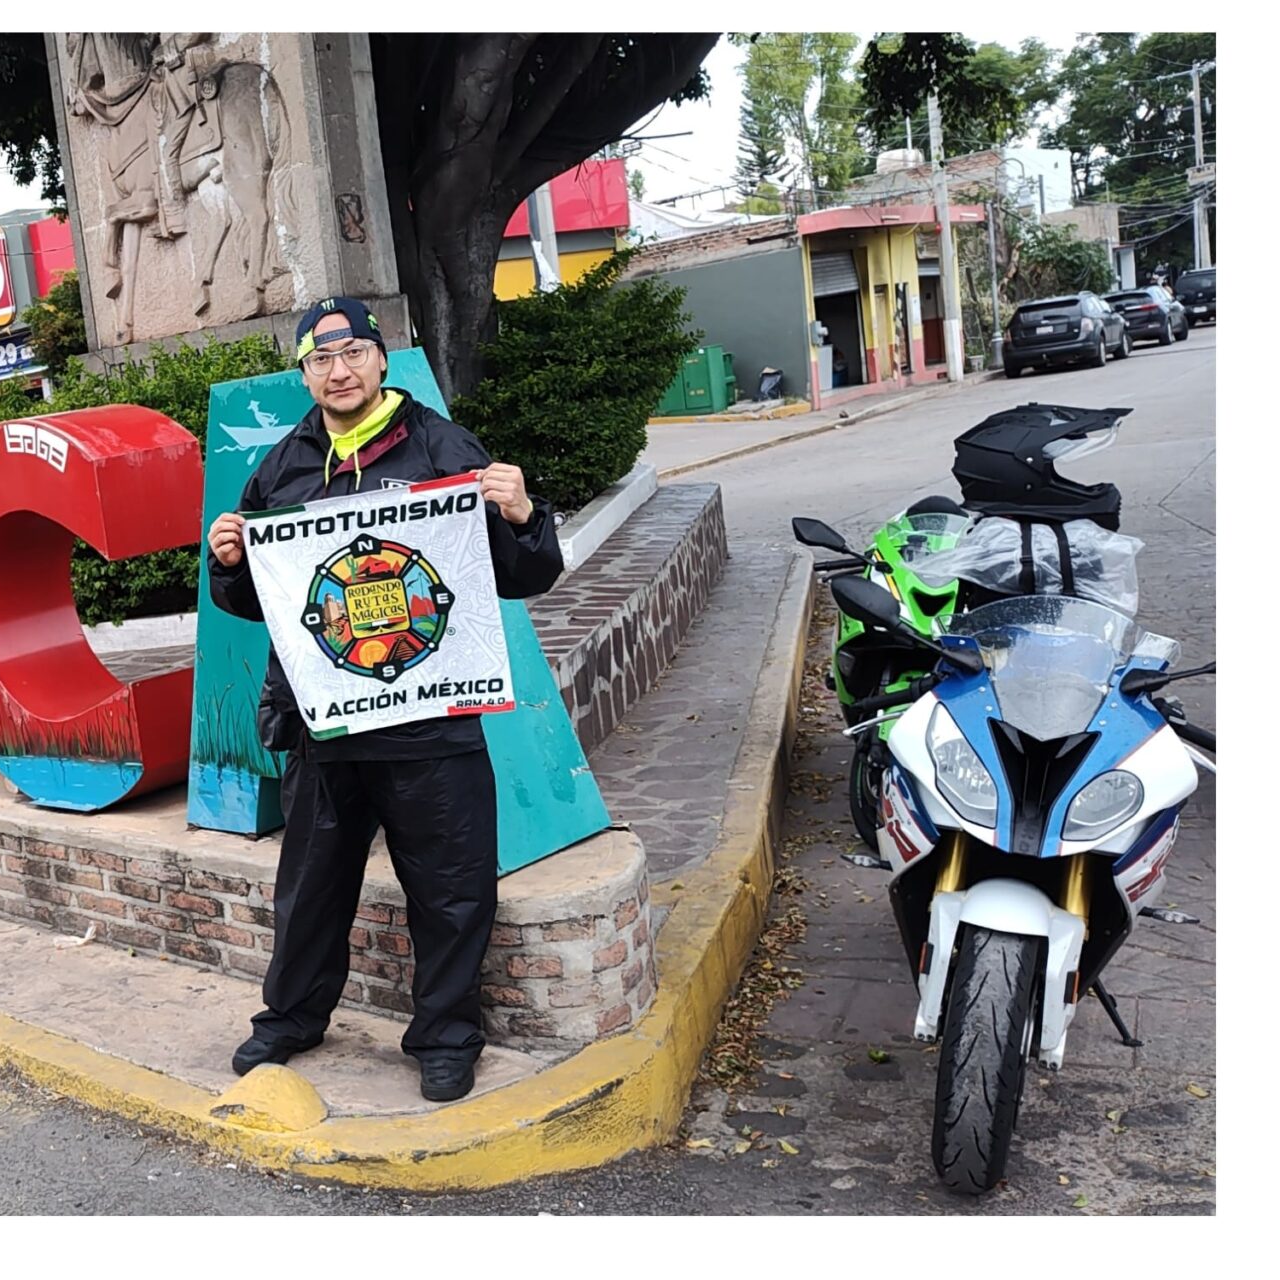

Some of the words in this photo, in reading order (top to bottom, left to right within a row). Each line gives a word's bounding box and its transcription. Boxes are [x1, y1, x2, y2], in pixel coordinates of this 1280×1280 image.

[358, 539, 374, 552] N
[436, 592, 450, 605] E
[306, 613, 321, 626] O
[382, 665, 396, 677] S
[326, 688, 408, 719] ACCIÓN
[417, 676, 504, 701] MÉXICO
[455, 698, 483, 709] RRM
